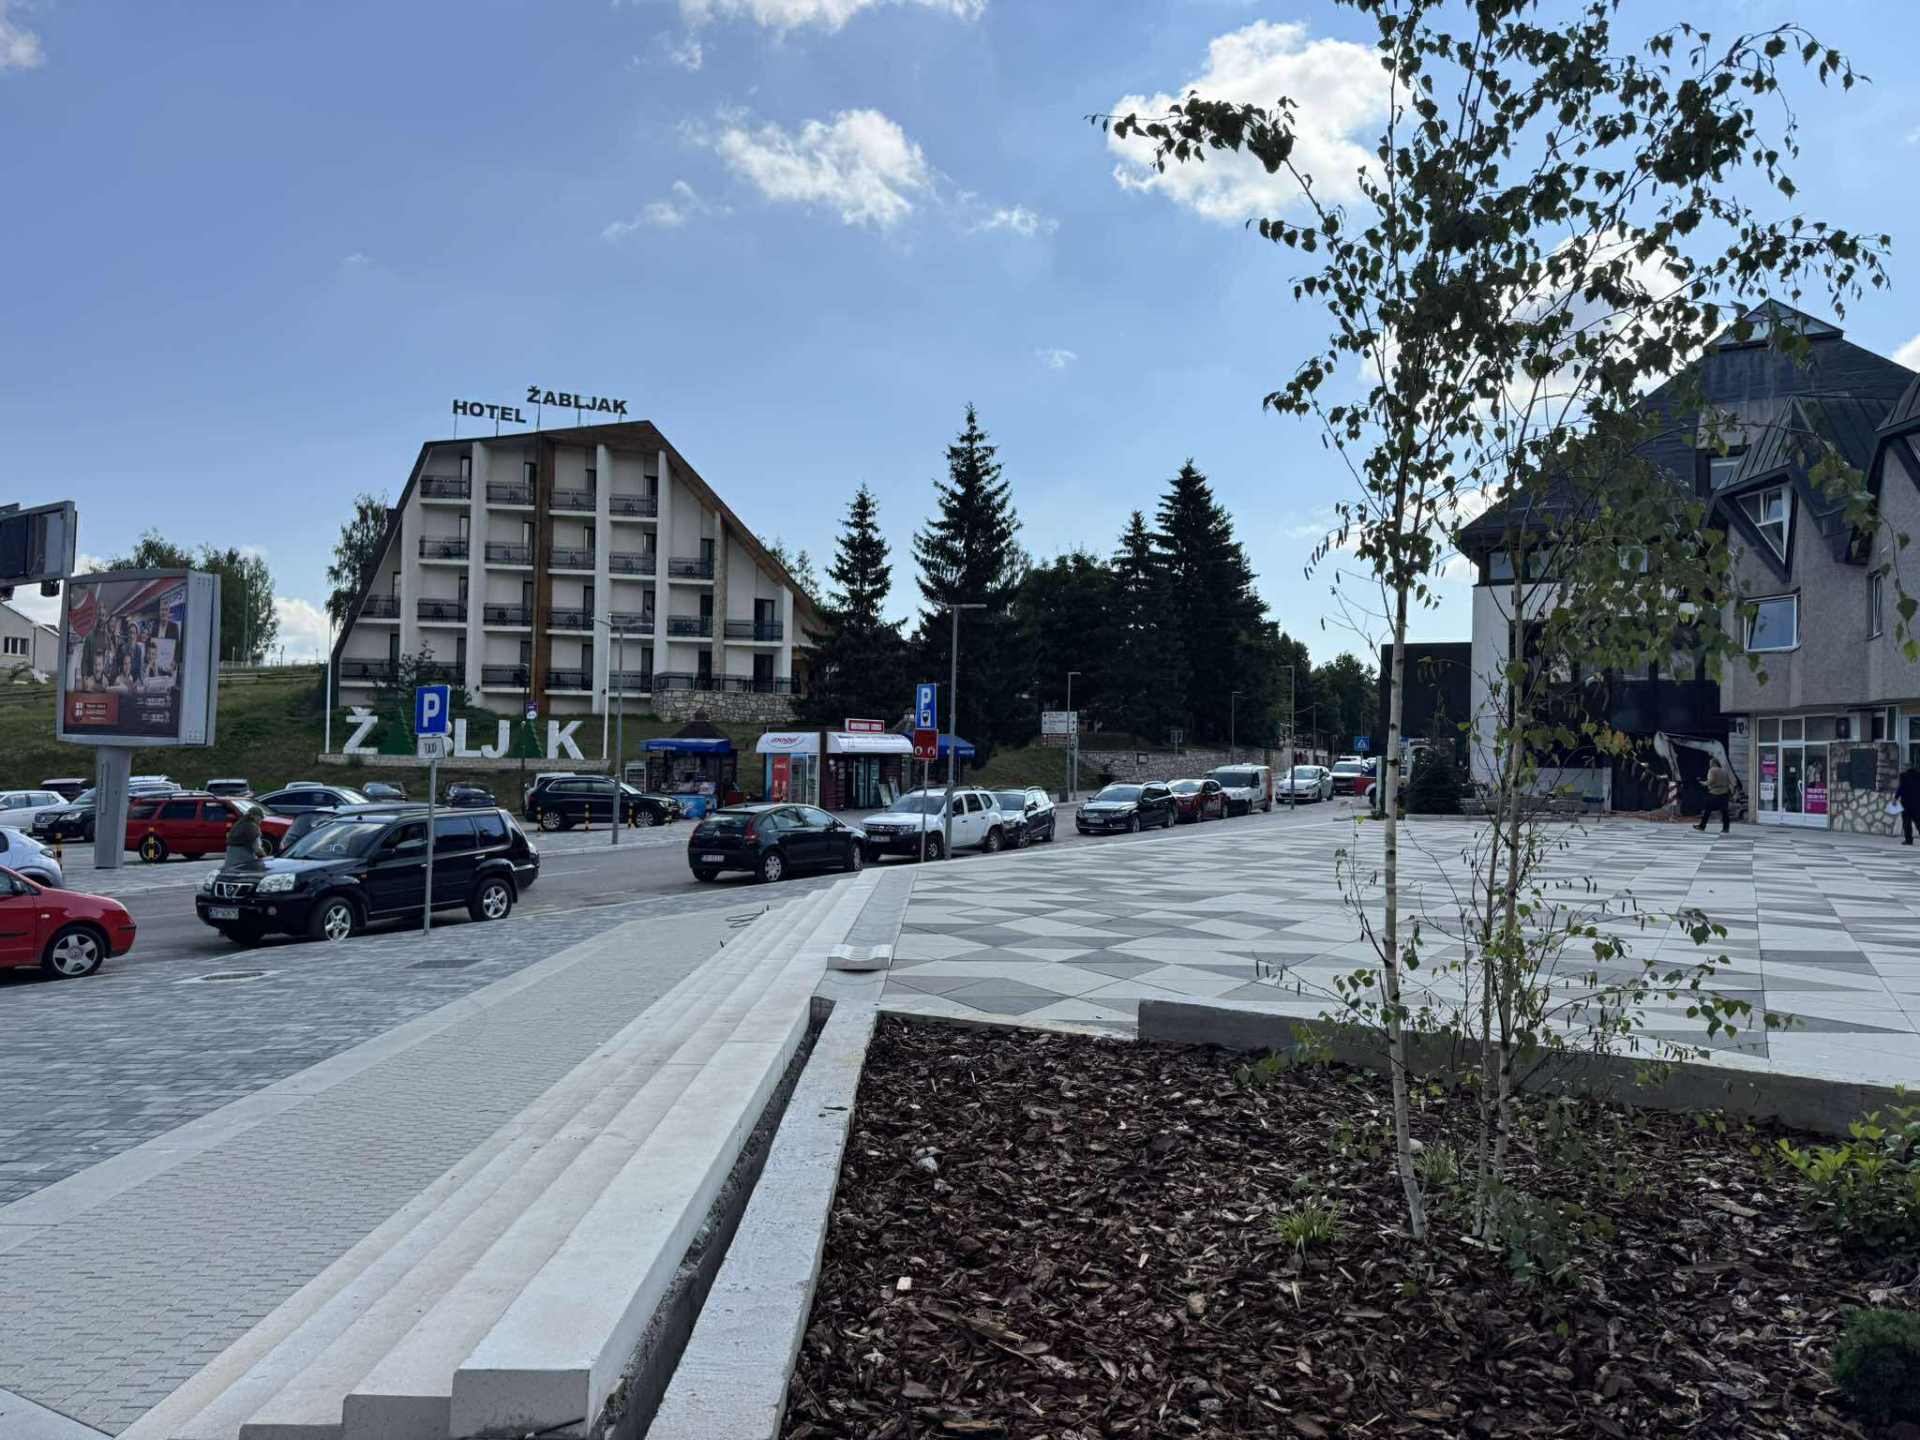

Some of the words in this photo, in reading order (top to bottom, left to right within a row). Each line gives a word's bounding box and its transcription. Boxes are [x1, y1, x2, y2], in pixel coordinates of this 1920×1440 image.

[452, 399, 527, 424] HOTEL
[526, 384, 628, 415] ŽABLJAK
[423, 692, 440, 728] P
[921, 687, 932, 711] P
[343, 705, 585, 761] ŽLJK
